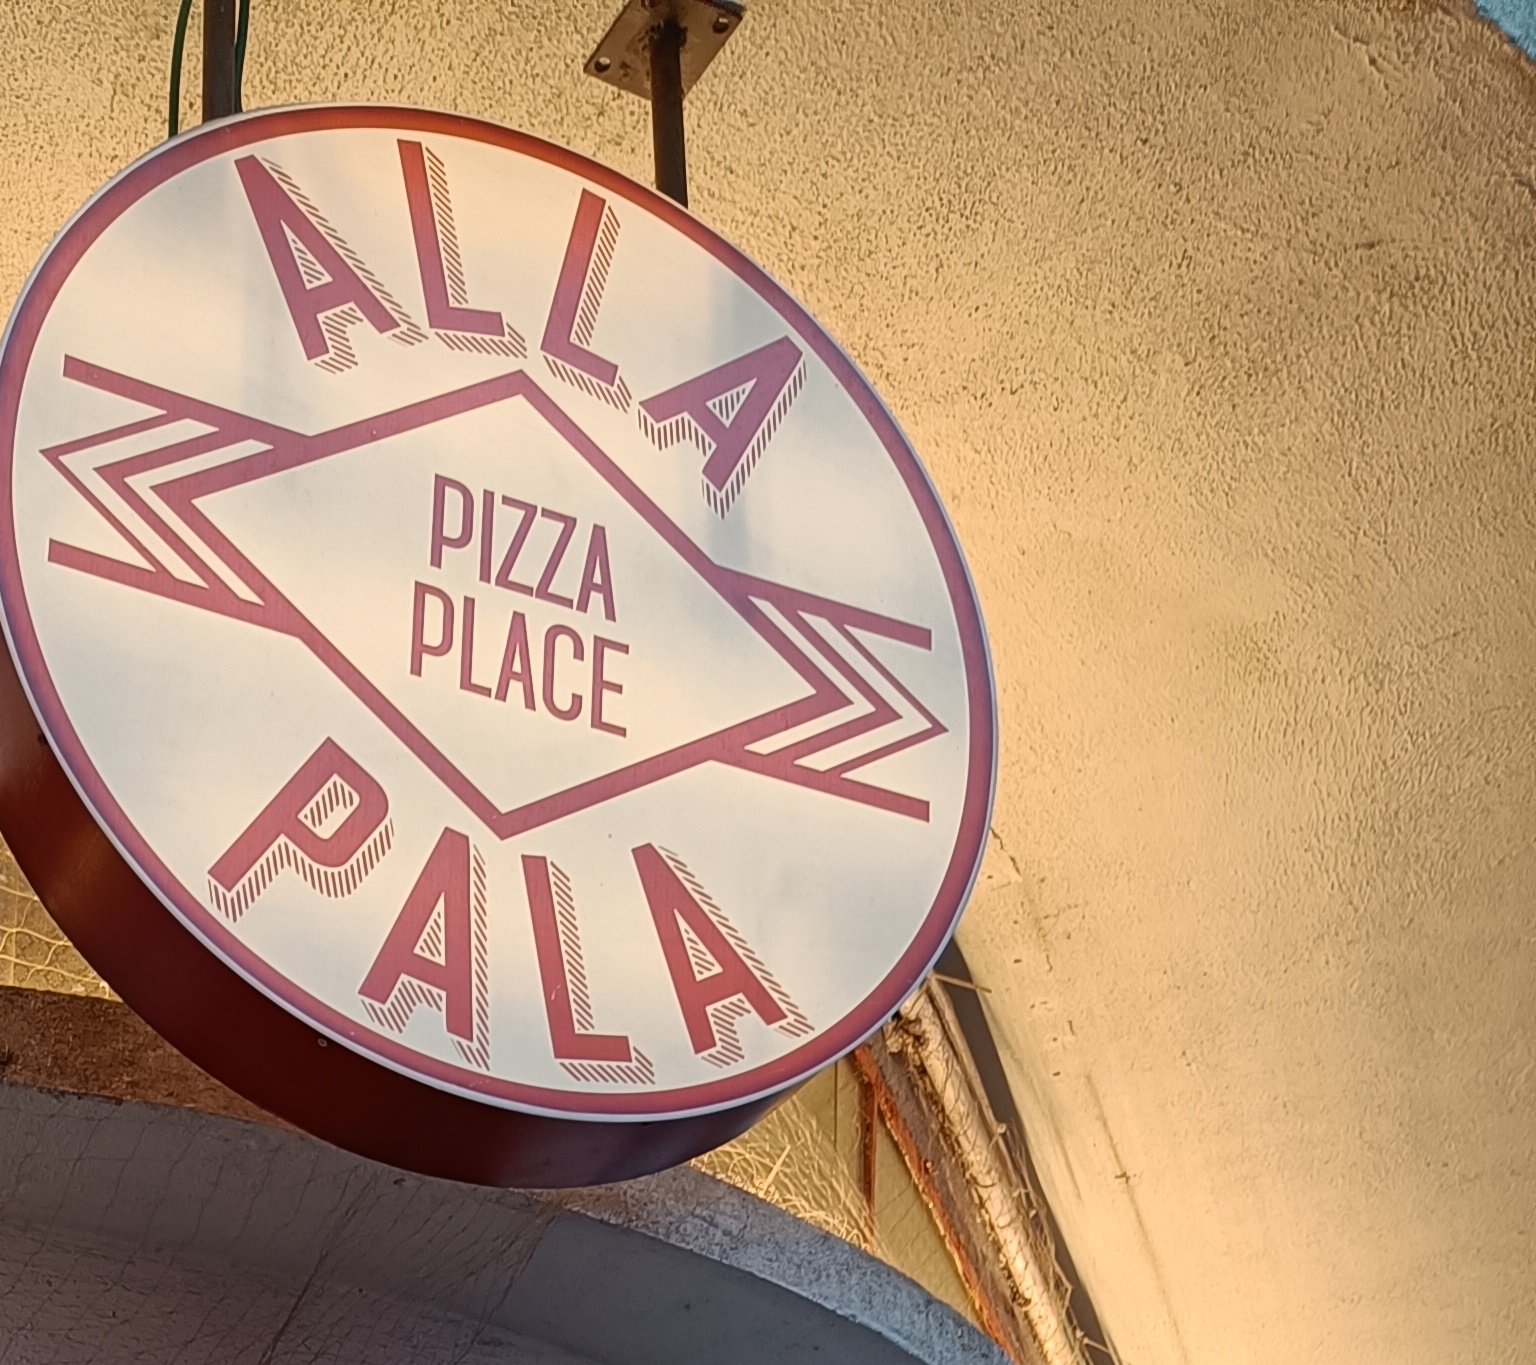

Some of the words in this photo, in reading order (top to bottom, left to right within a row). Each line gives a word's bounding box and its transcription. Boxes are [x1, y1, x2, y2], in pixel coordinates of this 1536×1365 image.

[233, 138, 807, 519] ALLA
[408, 578, 631, 739] PLACE
[429, 472, 618, 624] PIZZA
[207, 736, 815, 1085] PALA
